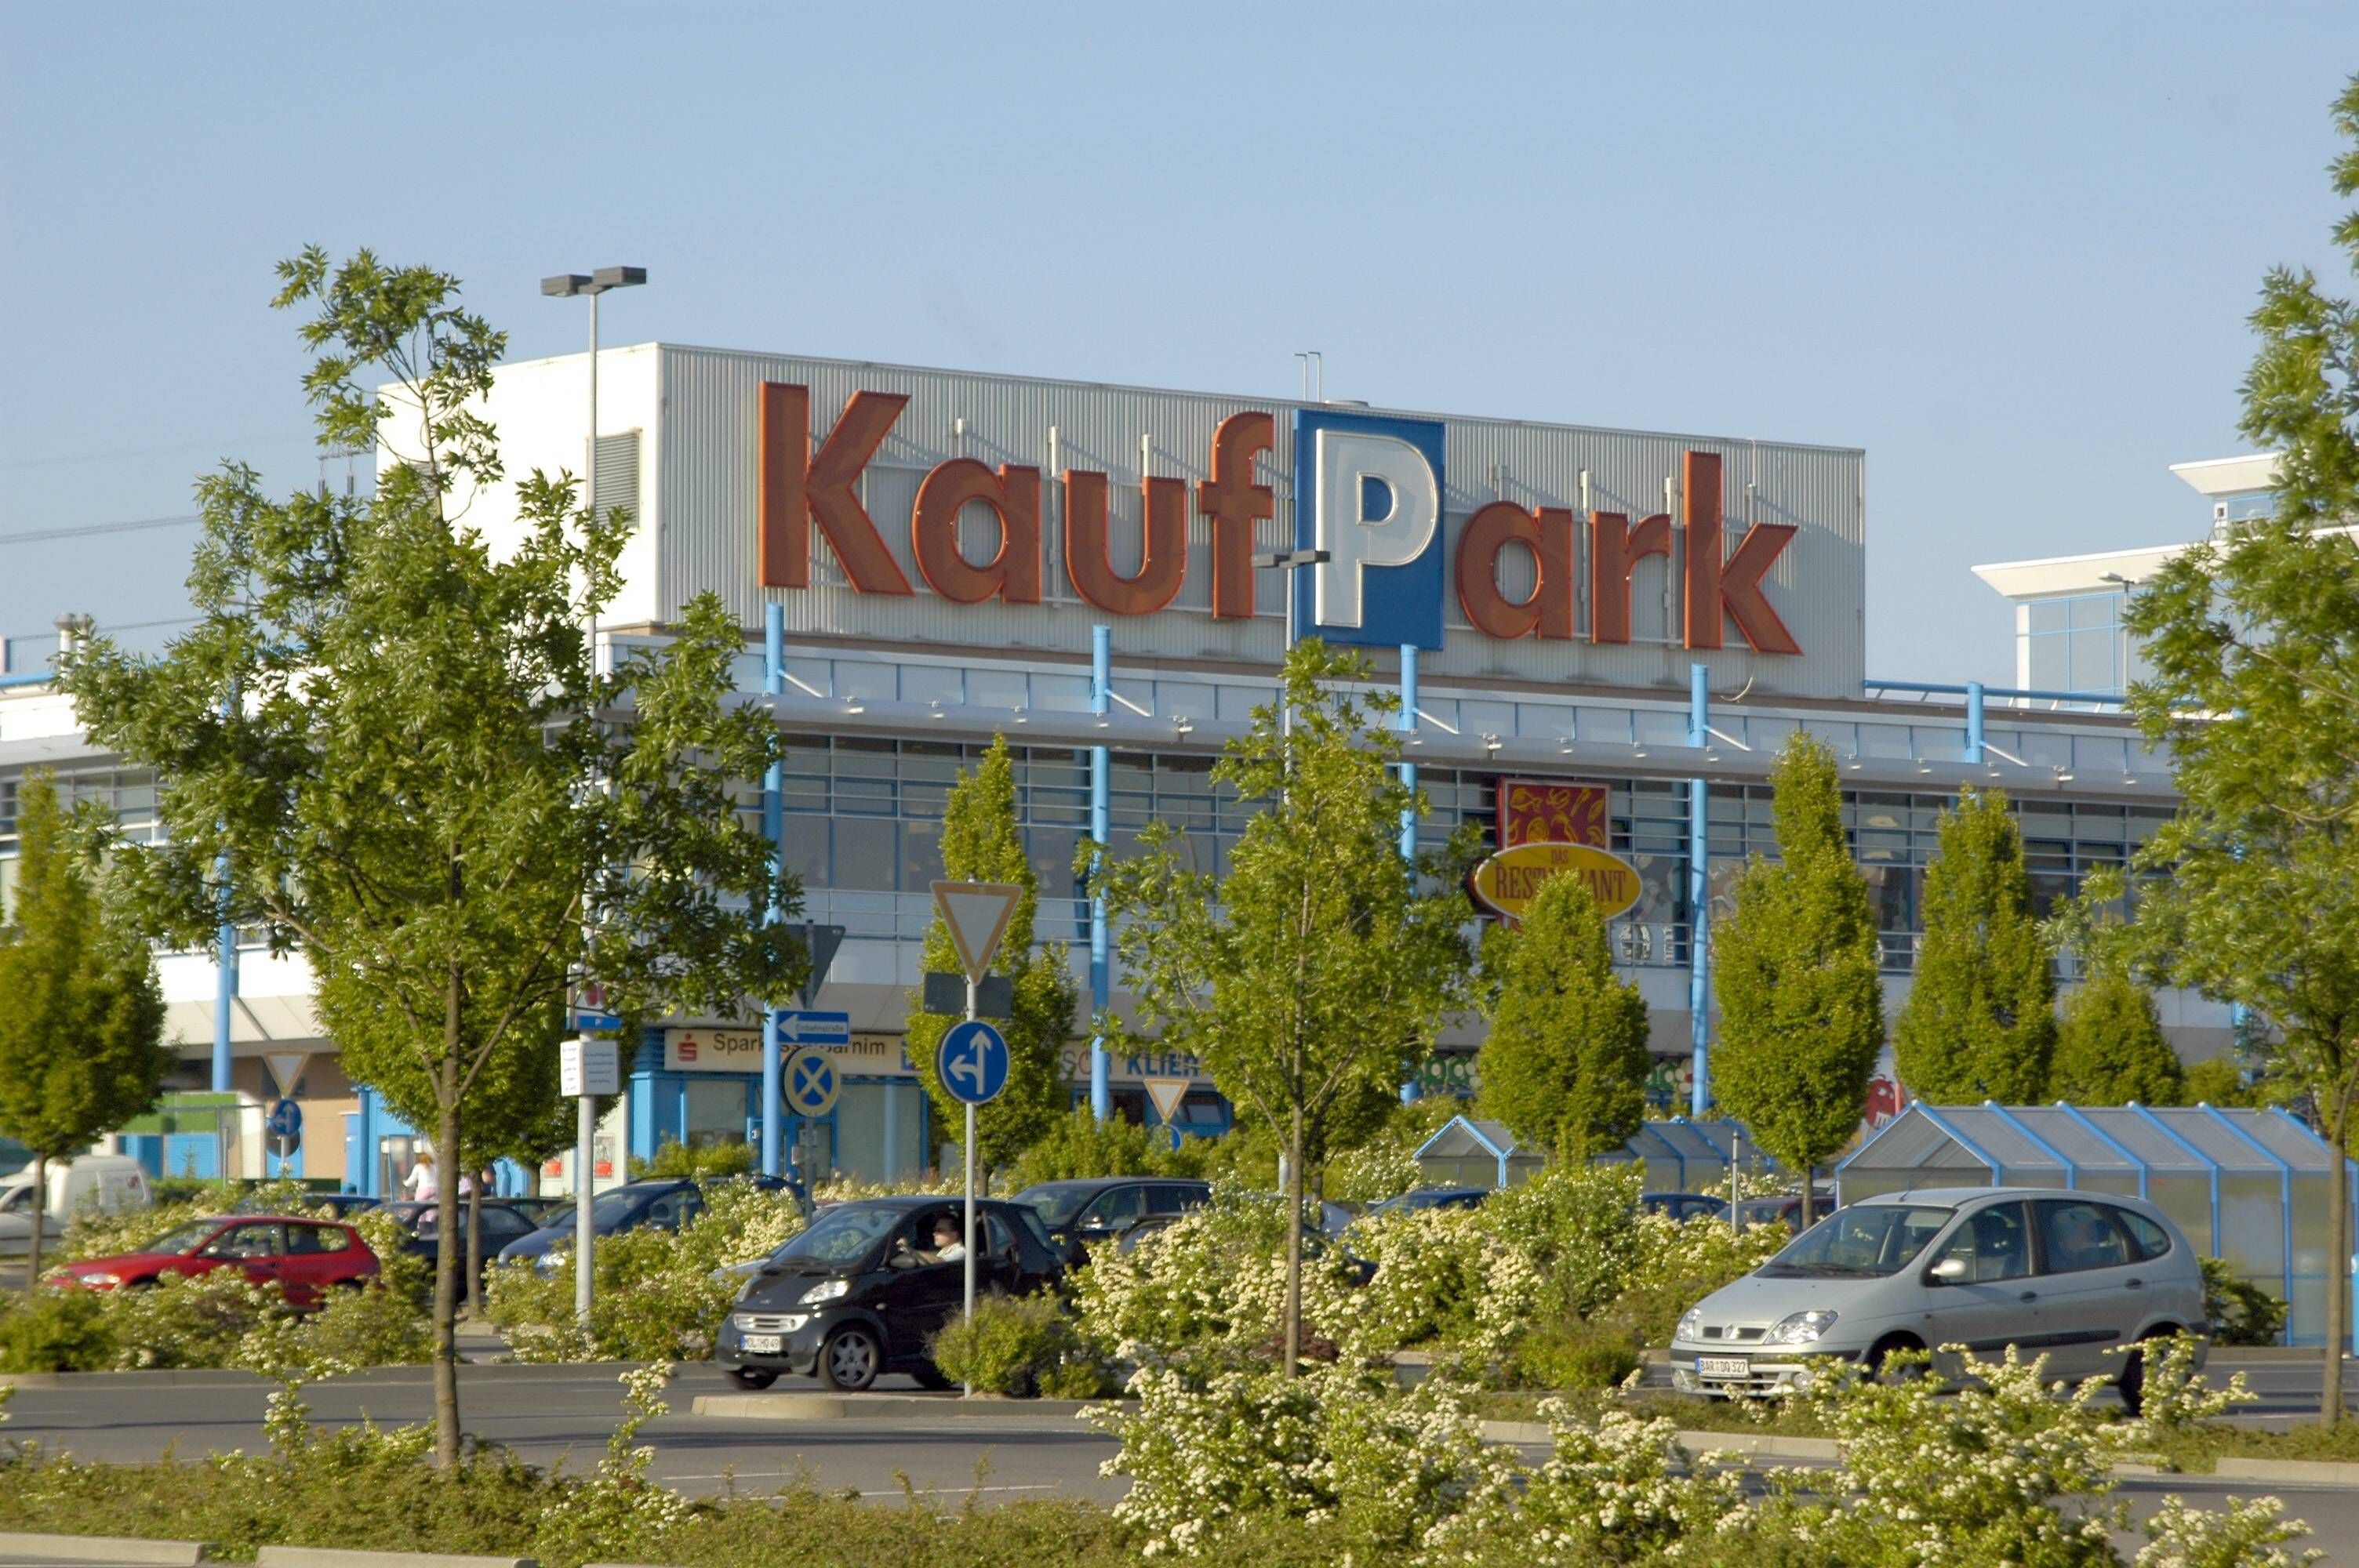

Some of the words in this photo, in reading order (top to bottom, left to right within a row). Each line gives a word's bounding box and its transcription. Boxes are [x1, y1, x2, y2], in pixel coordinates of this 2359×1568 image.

[1550, 849, 1568, 865] DAS
[1699, 1360, 1714, 1372] BAR
[1731, 1361, 1746, 1373] 327
